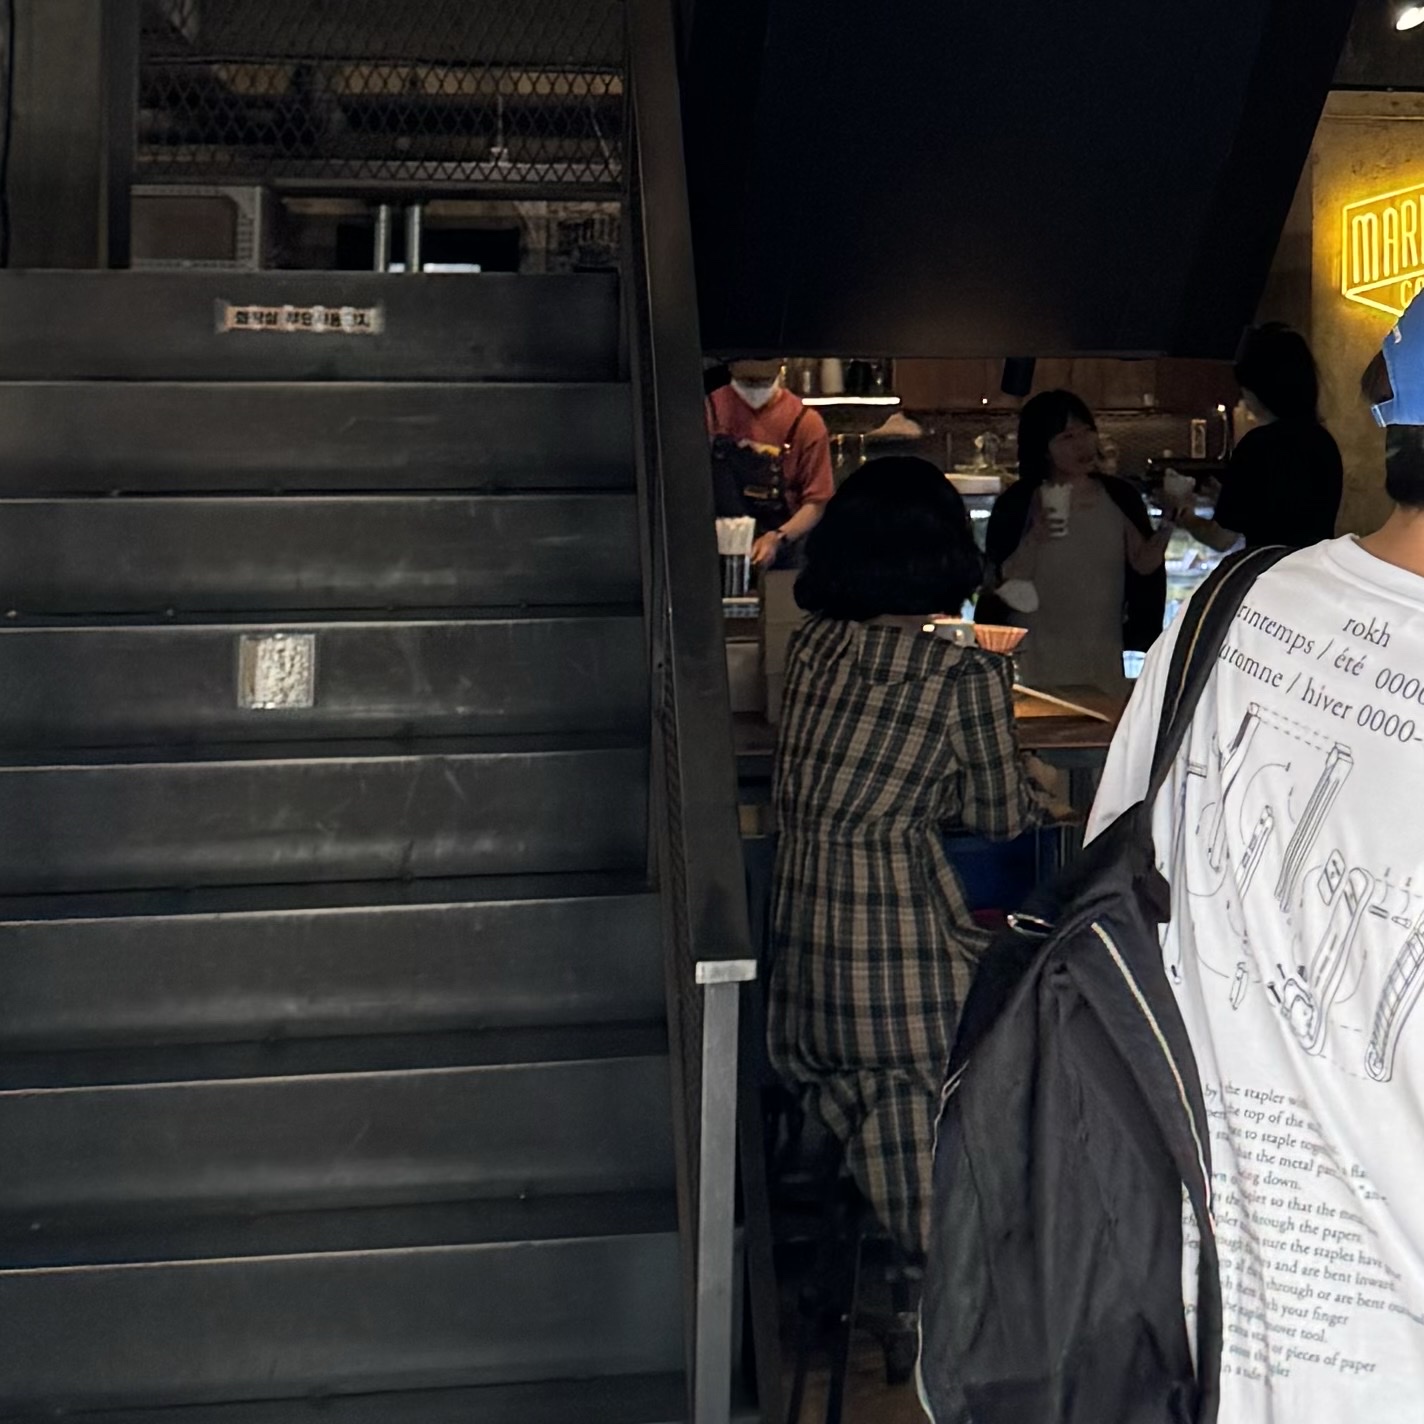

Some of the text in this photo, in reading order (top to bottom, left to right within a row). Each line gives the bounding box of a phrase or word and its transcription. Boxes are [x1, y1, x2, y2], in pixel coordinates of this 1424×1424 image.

[1342, 616, 1392, 648] rokh
[1334, 647, 1365, 677] été
[1301, 677, 1354, 721] hiver
[1244, 1087, 1286, 1104] stapler
[1244, 1108, 1265, 1125] top
[1268, 1110, 1284, 1124] of
[1285, 1114, 1304, 1129] the
[1245, 1128, 1258, 1140] to
[1261, 1133, 1298, 1150] staple
[1256, 1148, 1275, 1164] the
[1279, 1154, 1314, 1172] metal
[1263, 1171, 1303, 1190] down.
[1288, 1197, 1312, 1214] that
[1316, 1202, 1336, 1218] the
[1299, 1219, 1319, 1236] the
[1290, 1240, 1311, 1255] the
[1314, 1246, 1355, 1264] staples
[1275, 1260, 1298, 1275] and
[1302, 1264, 1320, 1277] are
[1323, 1266, 1352, 1283] bent
[1266, 1279, 1314, 1301] through
[1317, 1289, 1332, 1300] or
[1334, 1293, 1354, 1305] are
[1357, 1293, 1386, 1310] bent
[1281, 1304, 1309, 1321] your
[1313, 1306, 1350, 1327] finger
[1301, 1327, 1327, 1344] tool.
[1286, 1346, 1321, 1364] pieces
[1323, 1352, 1339, 1367] of
[1340, 1357, 1376, 1374] paper
